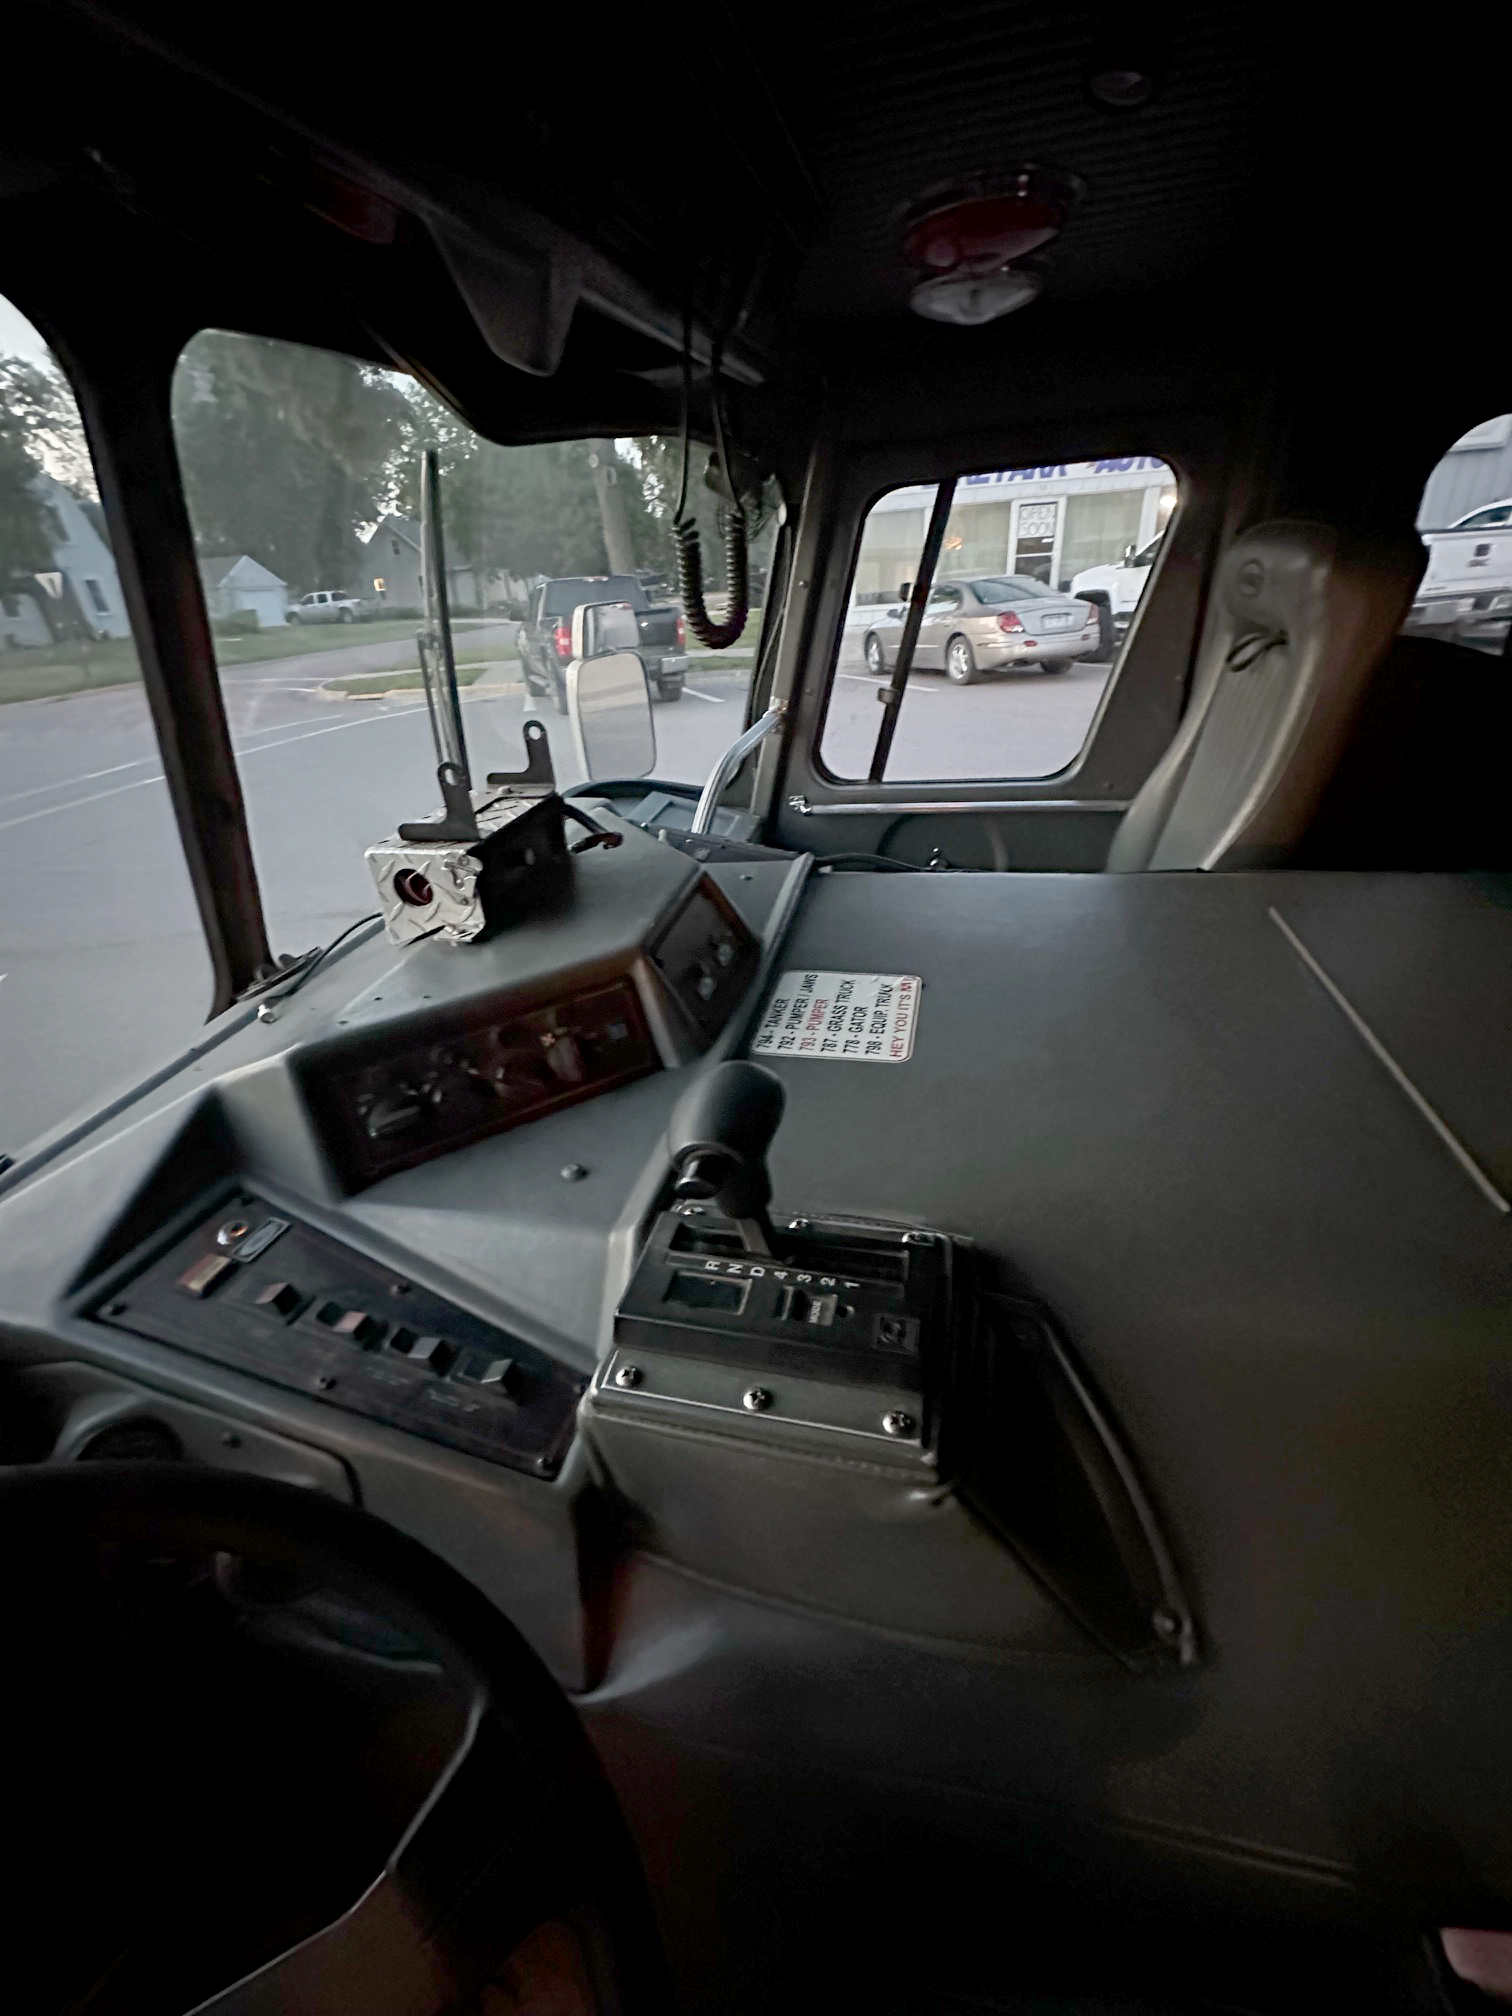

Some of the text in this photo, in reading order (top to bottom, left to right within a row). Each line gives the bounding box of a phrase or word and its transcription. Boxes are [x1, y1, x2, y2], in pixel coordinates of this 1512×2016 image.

[800, 974, 818, 993] JAWS
[835, 979, 857, 1003] TRUCK
[875, 983, 893, 1008] TRUCK
[898, 995, 911, 1011] IT'S
[757, 1035, 773, 1049] 794
[765, 998, 790, 1029] TANKER
[785, 998, 810, 1030] PUMPER
[806, 998, 830, 1031] PUMPER
[828, 1004, 848, 1032] GRASS
[849, 1006, 869, 1033] GATOR
[870, 1008, 889, 1035] EQUIP.
[894, 1013, 908, 1036] YOU
[778, 1036, 795, 1050] 792
[799, 1038, 817, 1051] 793
[821, 1038, 838, 1052] 787
[843, 1040, 860, 1053] 778
[865, 1040, 882, 1055] 798
[890, 1037, 905, 1058] HEY
[705, 1260, 861, 1289] R N D 4 3 2 1
[808, 1300, 823, 1323] MODE
